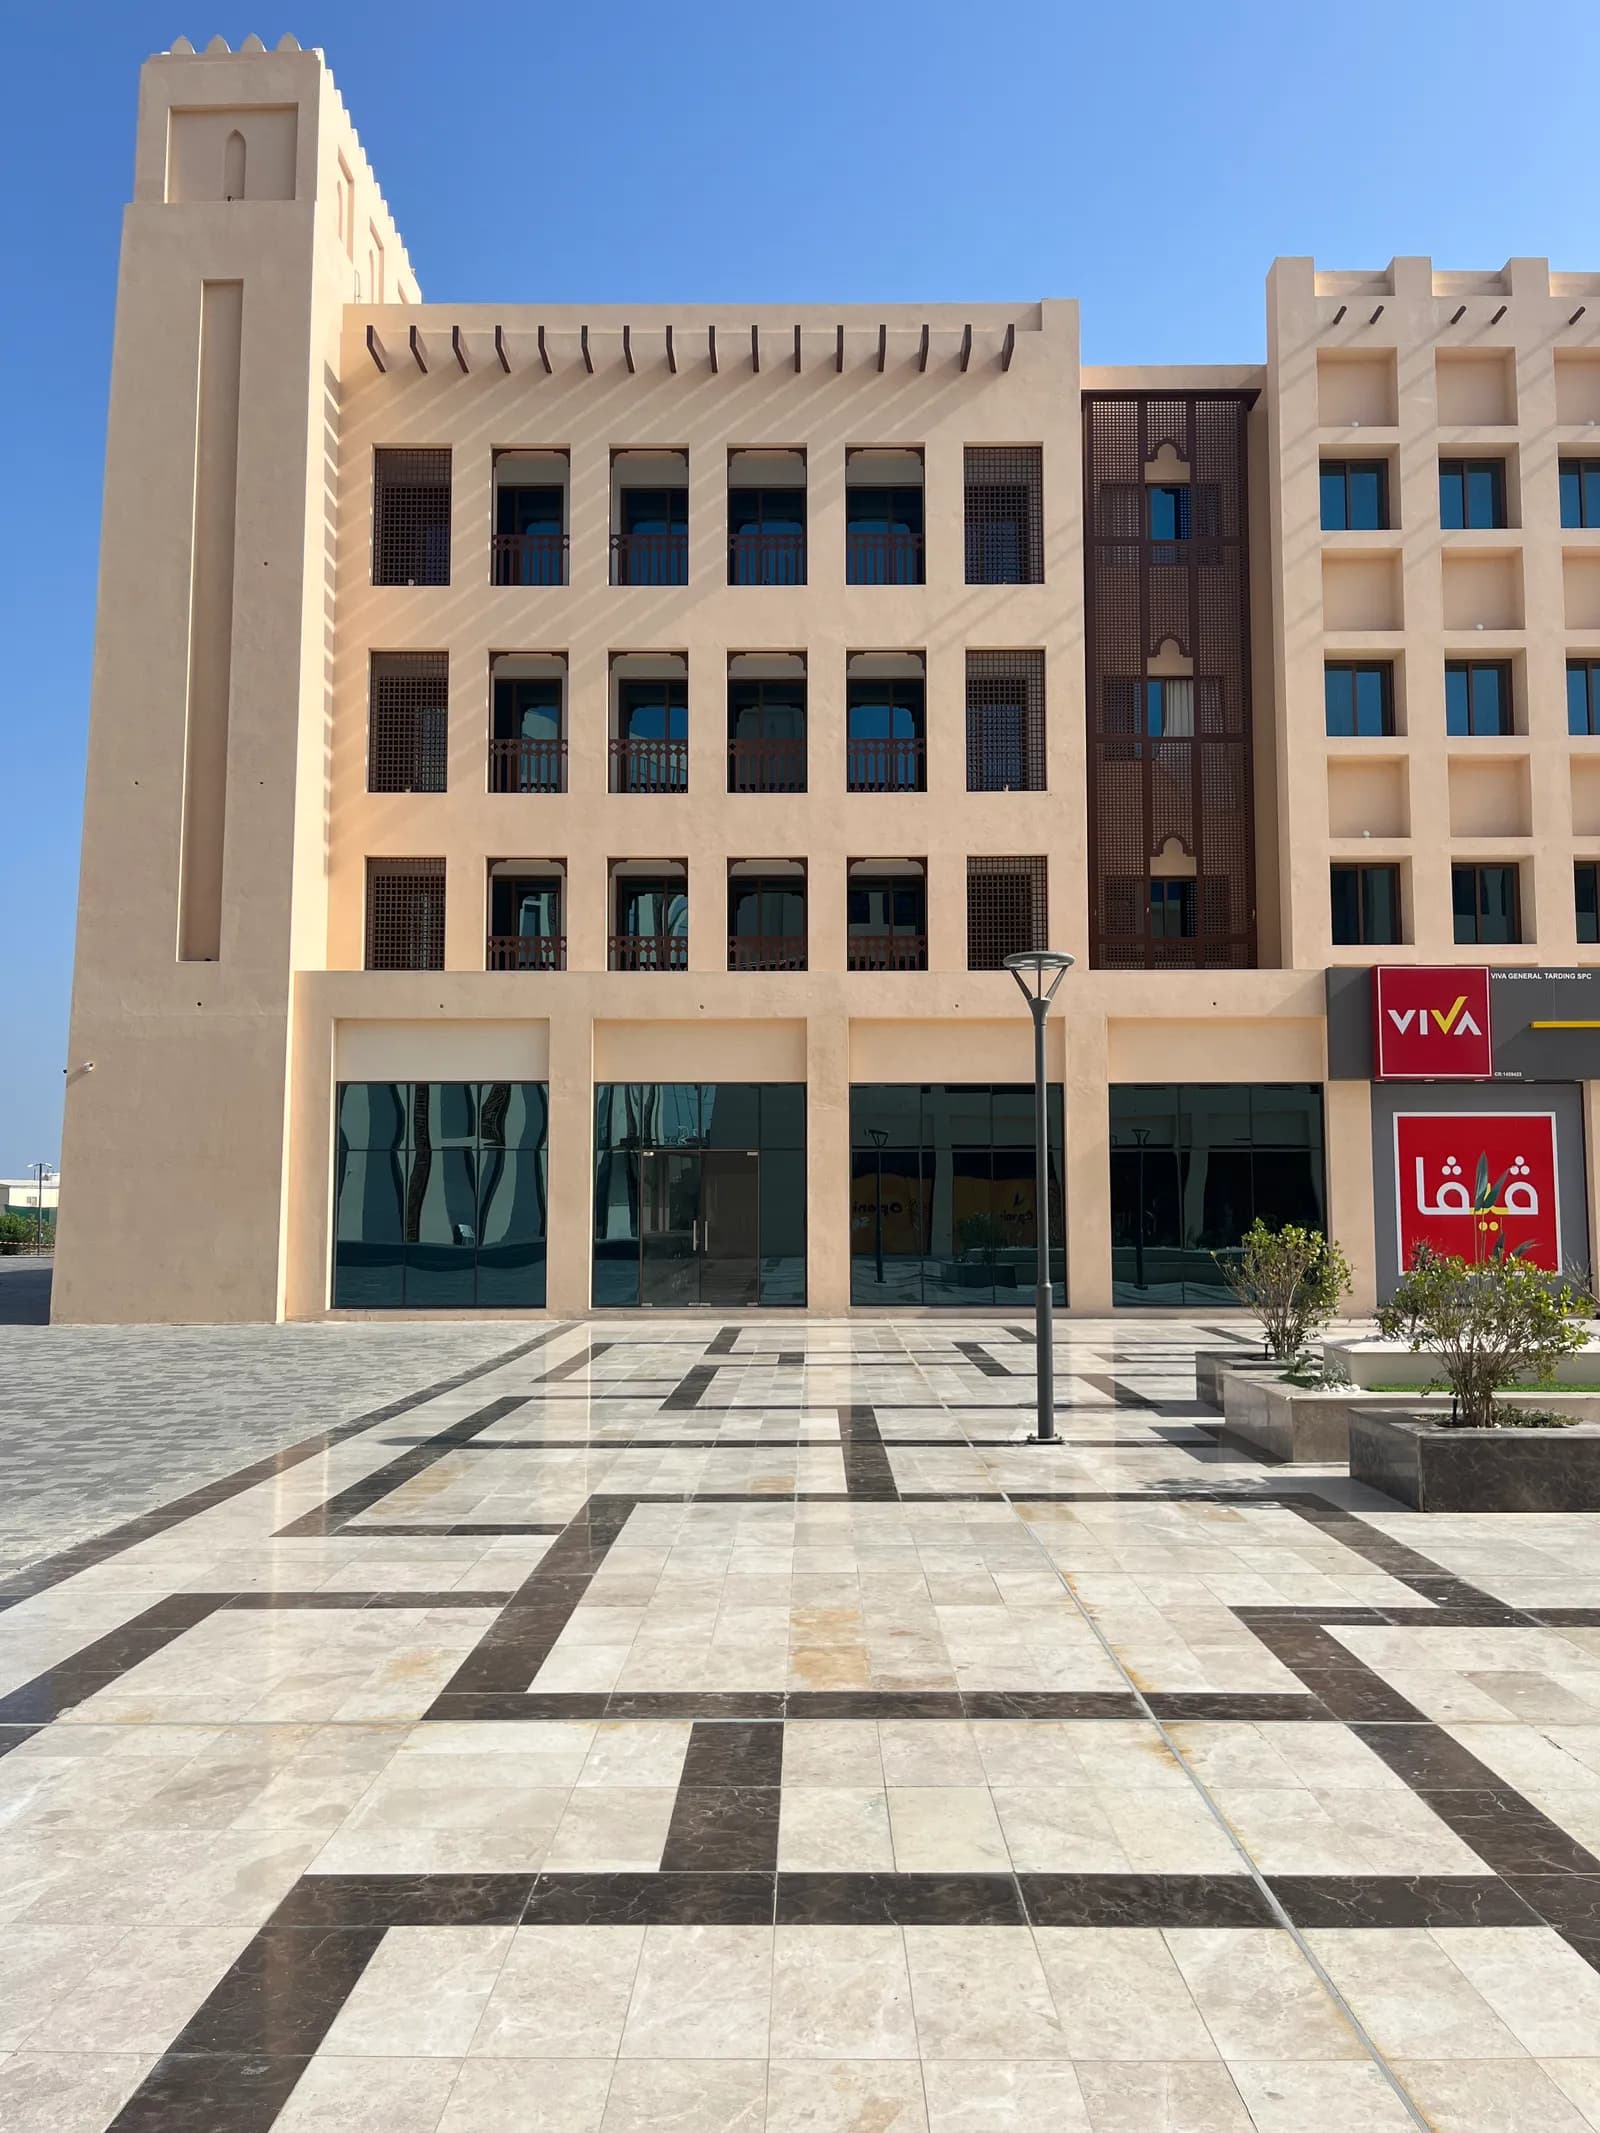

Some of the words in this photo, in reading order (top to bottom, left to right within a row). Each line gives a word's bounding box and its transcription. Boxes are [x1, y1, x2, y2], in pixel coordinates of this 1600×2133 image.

[1490, 972, 1507, 980] VIVA
[1507, 972, 1542, 980] GENERAL
[1544, 972, 1576, 980] TARDING
[1577, 972, 1592, 980] SPC
[1387, 996, 1482, 1036] VIVA
